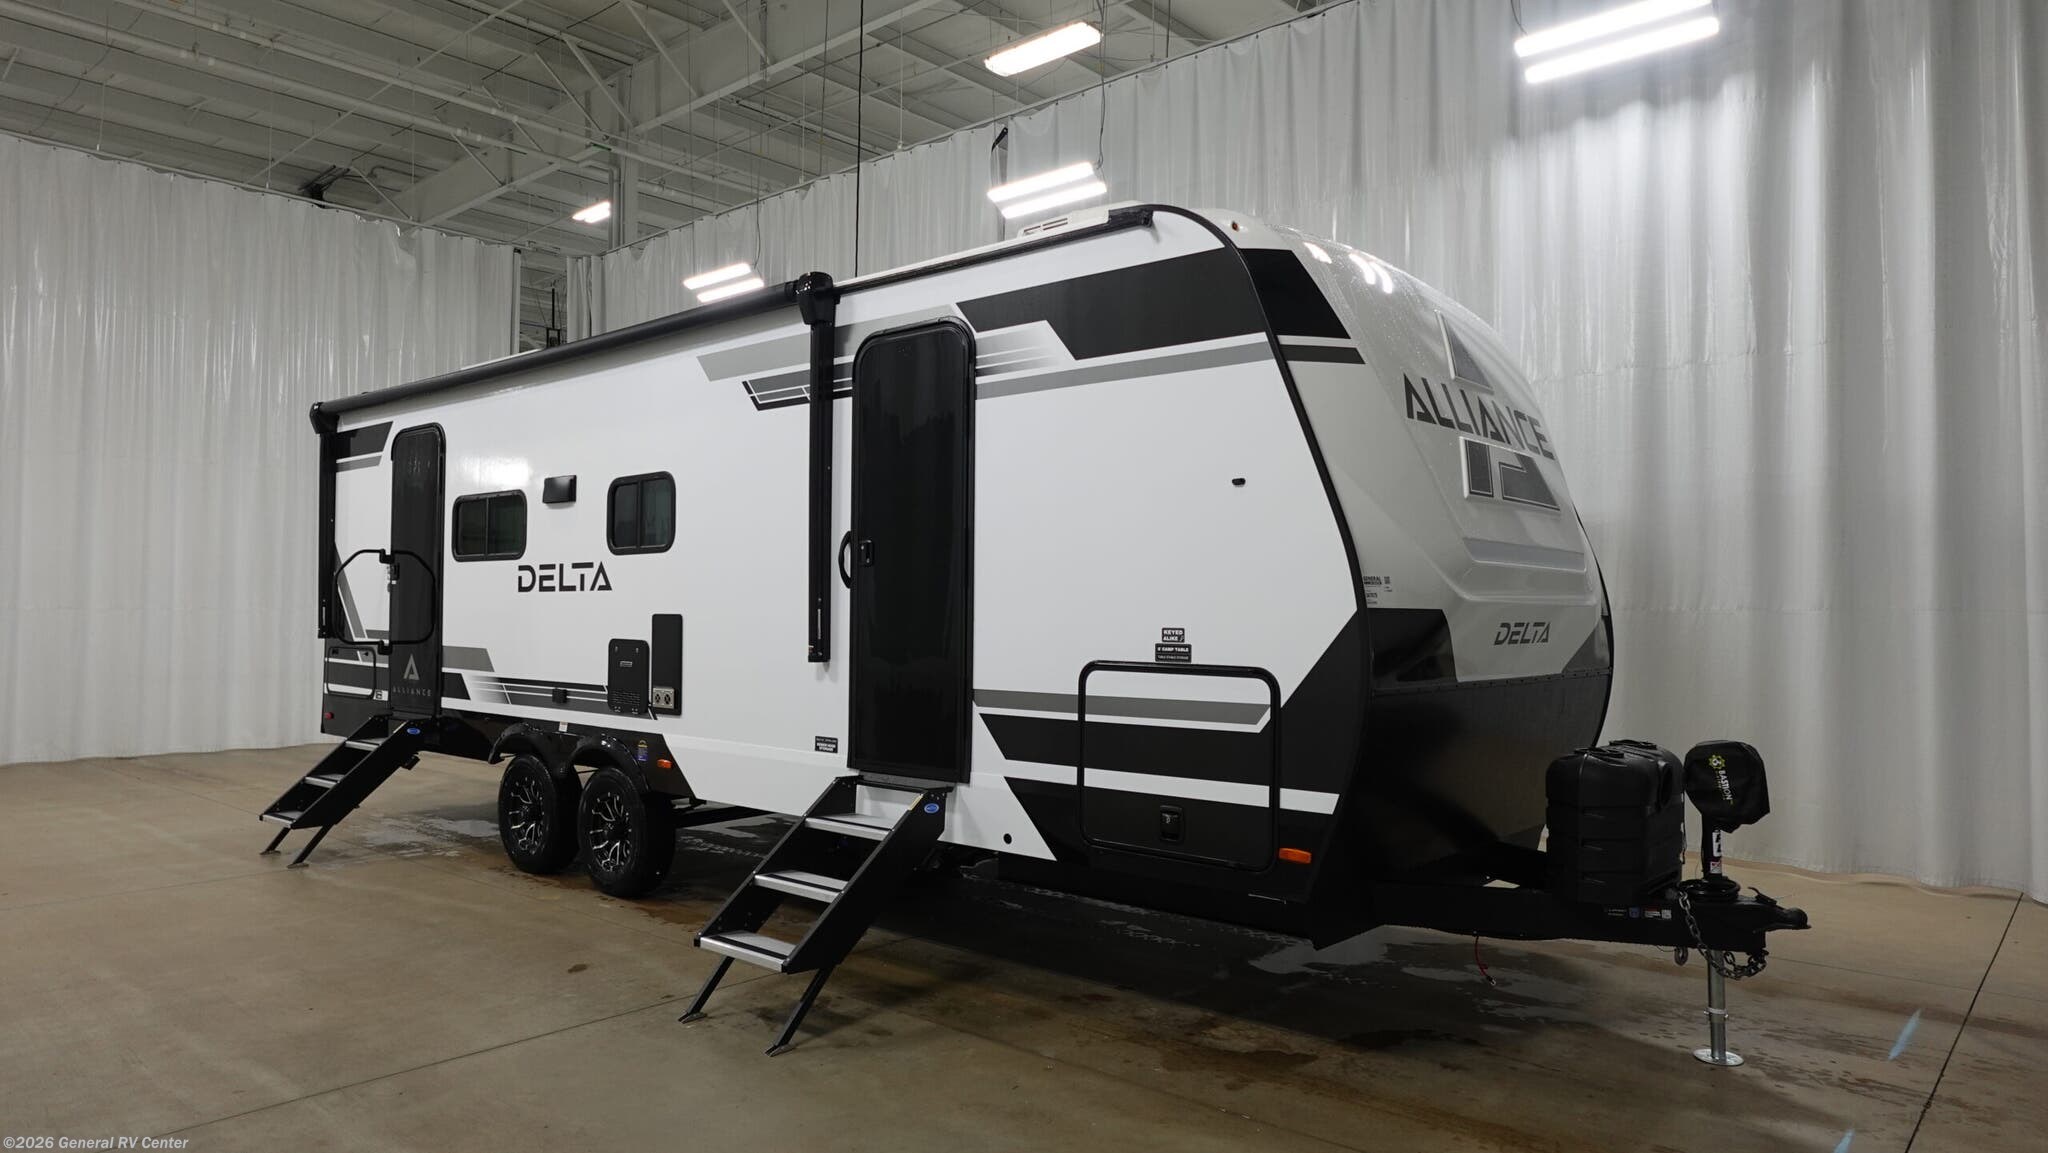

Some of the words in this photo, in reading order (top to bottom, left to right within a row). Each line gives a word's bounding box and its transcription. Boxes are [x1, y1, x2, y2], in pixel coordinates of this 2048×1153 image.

[1403, 372, 1555, 461] ALLIANCE
[517, 561, 612, 592] DELTA
[1494, 622, 1551, 645] DELTA
[392, 685, 431, 697] ALLIANCE
[1719, 769, 1733, 801] BASTION
